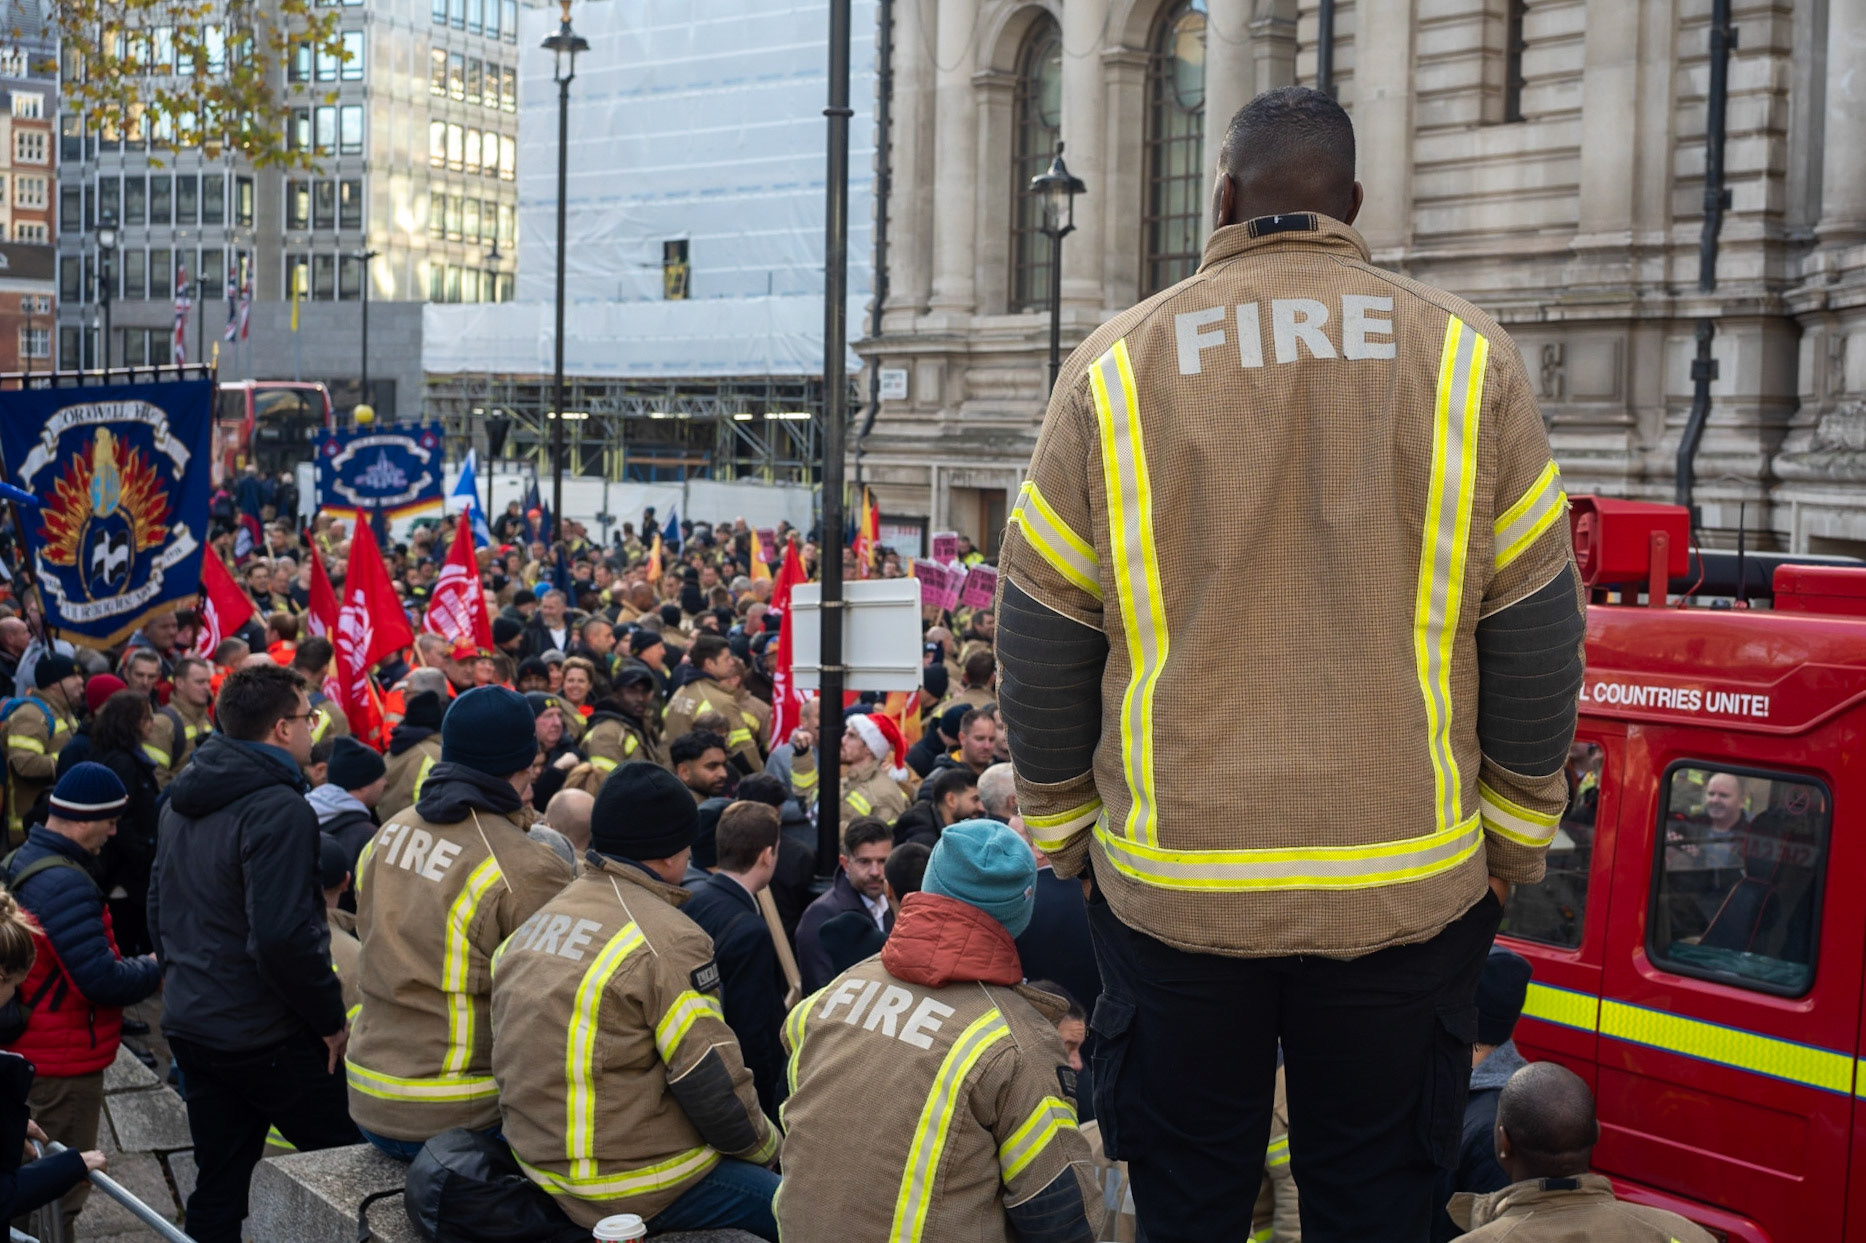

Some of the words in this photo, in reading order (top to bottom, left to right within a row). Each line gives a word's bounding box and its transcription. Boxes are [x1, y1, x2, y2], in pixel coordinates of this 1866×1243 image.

[1175, 294, 1396, 375] FIRE
[1593, 682, 1702, 711] COUNTRIES
[1706, 691, 1769, 717] UNITE!
[369, 823, 463, 883] FIRE
[511, 913, 603, 960] FIRE
[818, 978, 956, 1050] FIRE
